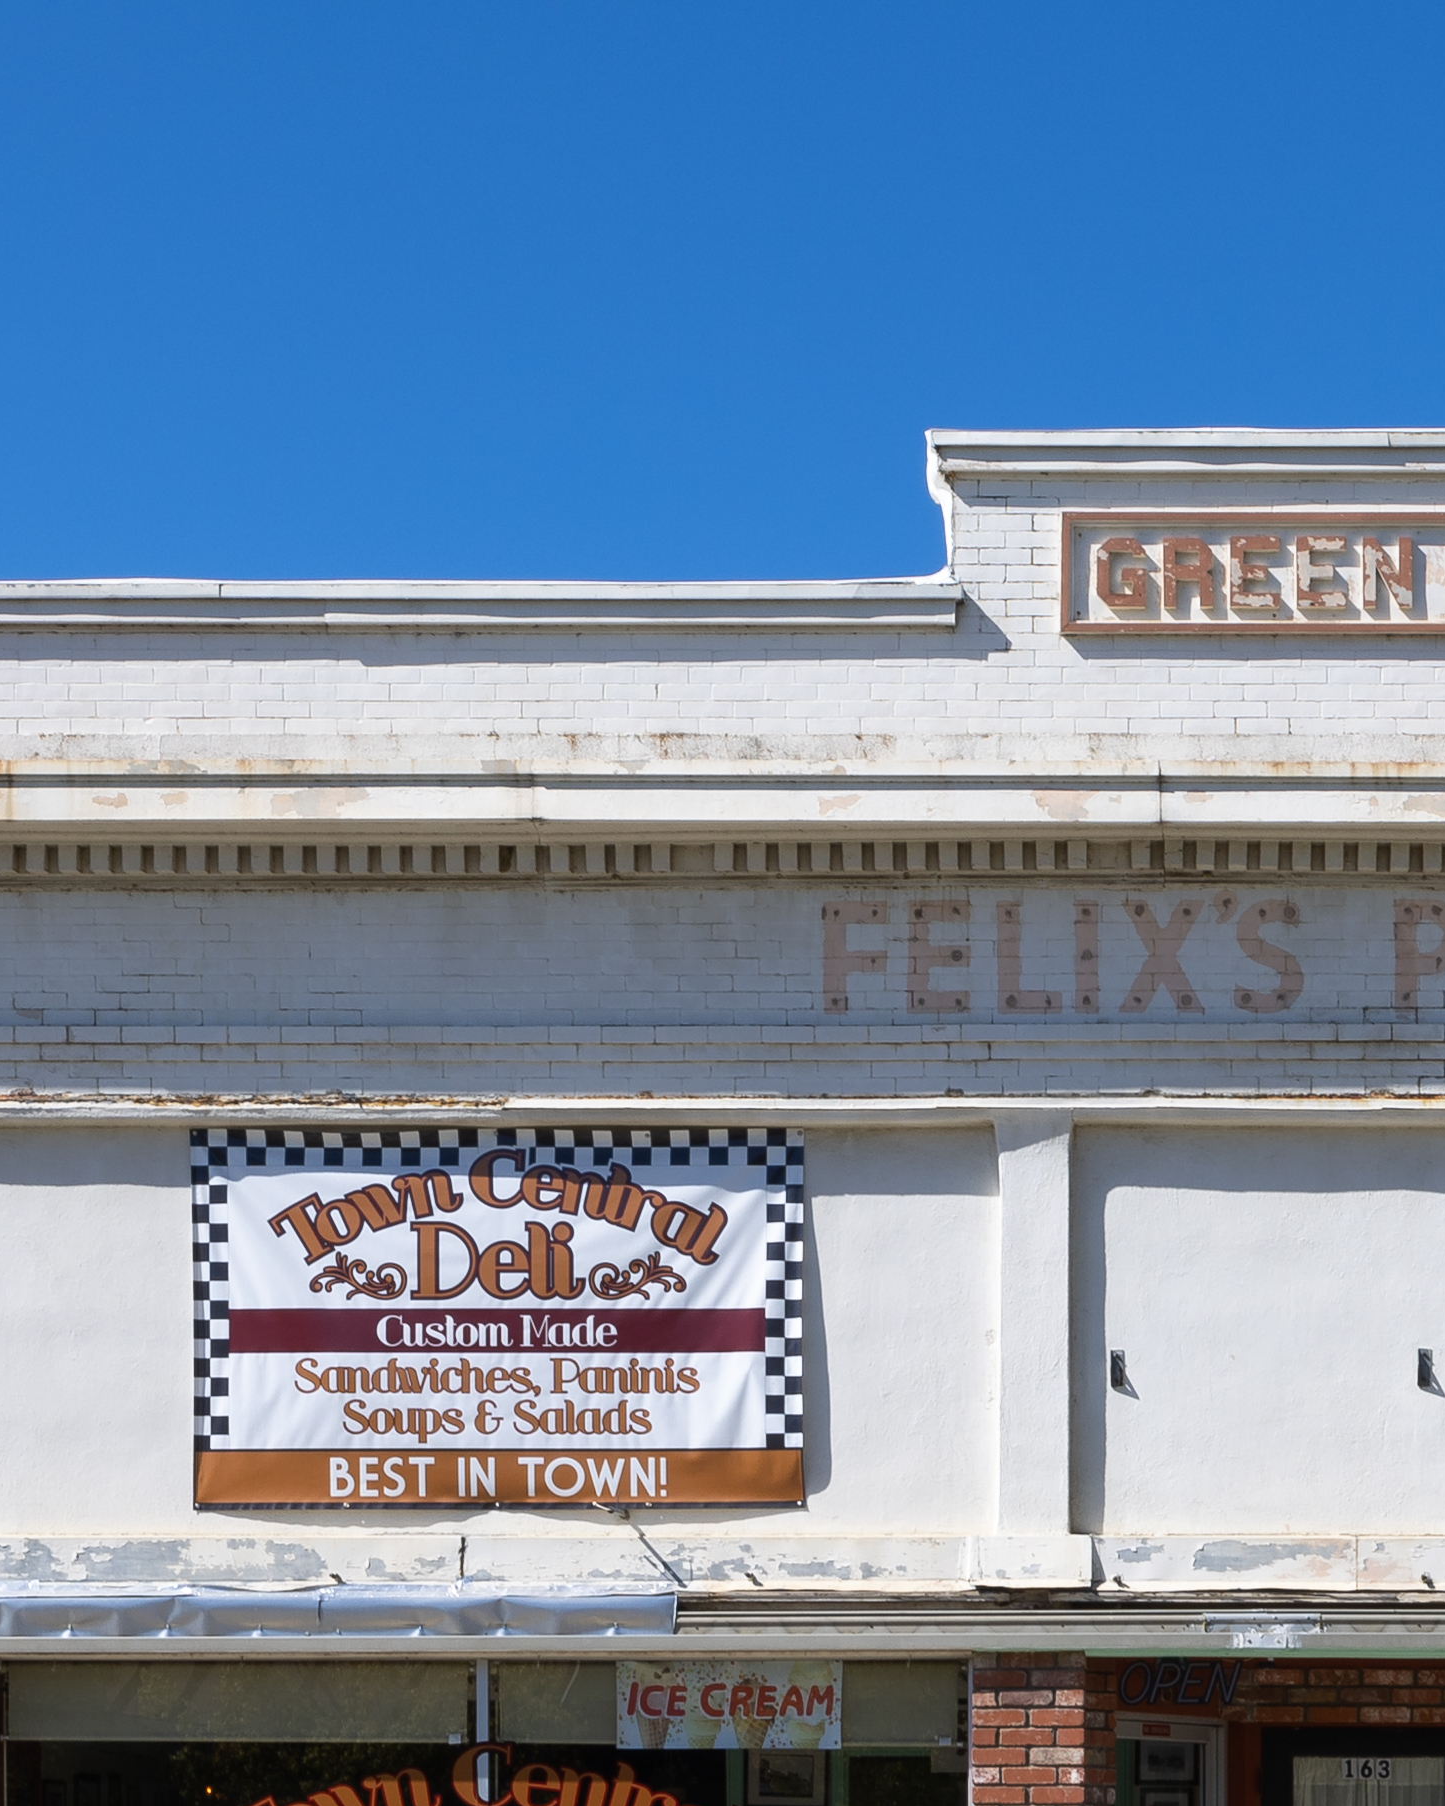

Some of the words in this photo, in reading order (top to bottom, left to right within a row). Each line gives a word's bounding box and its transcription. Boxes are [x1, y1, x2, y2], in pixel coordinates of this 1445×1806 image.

[1096, 535, 1414, 610] GREEN
[819, 896, 1307, 1016] FELIX'S
[268, 1168, 463, 1266] Town
[468, 1146, 730, 1267] Central
[409, 1220, 586, 1301] Deli
[375, 1313, 513, 1348] Custom
[519, 1314, 618, 1348] Made
[294, 1356, 541, 1397] Sandwiches,
[549, 1357, 701, 1395] Paninis
[341, 1399, 465, 1444] Soups
[475, 1399, 503, 1436] &
[512, 1399, 654, 1436] Salads
[328, 1456, 437, 1499] BEST
[456, 1456, 497, 1498] IN
[518, 1456, 669, 1499] TOWN!
[626, 1681, 688, 1717] ICE
[700, 1683, 834, 1717] CREAM
[1120, 1660, 1243, 1704] OPEN
[1344, 1759, 1391, 1779] 163
